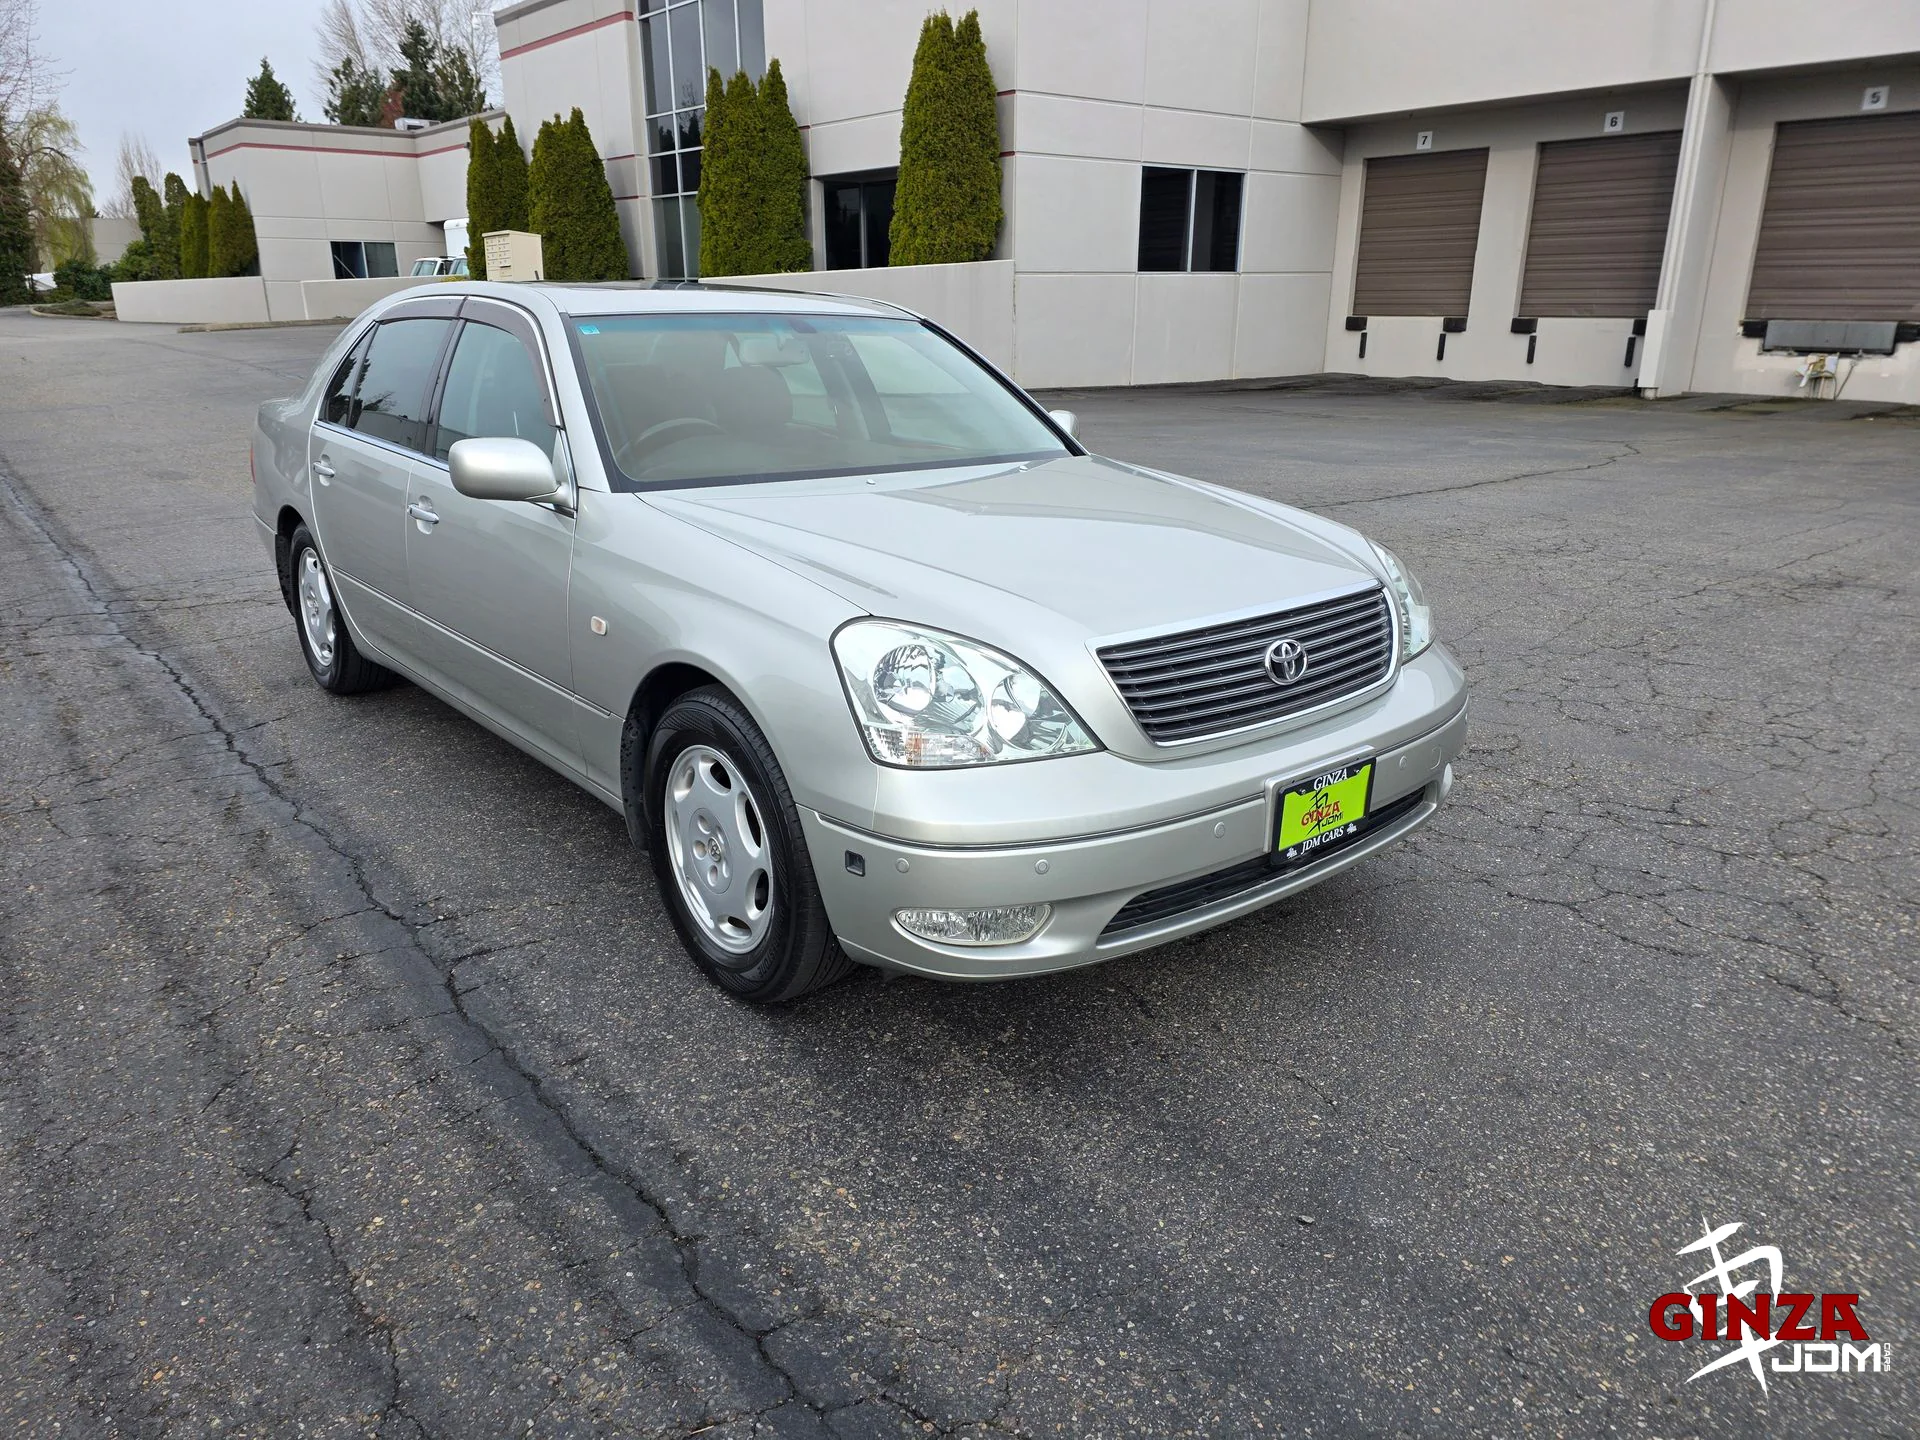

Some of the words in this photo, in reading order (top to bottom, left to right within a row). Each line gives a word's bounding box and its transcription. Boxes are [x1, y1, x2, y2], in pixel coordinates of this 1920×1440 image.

[1871, 91, 1881, 104] 5
[1610, 116, 1618, 127] 6
[1422, 135, 1428, 145] 7
[1313, 768, 1348, 791] GINZA
[1301, 800, 1340, 827] GINZA
[1321, 812, 1342, 828] JDM
[1301, 837, 1320, 855] JDM
[1322, 826, 1344, 843] CARS
